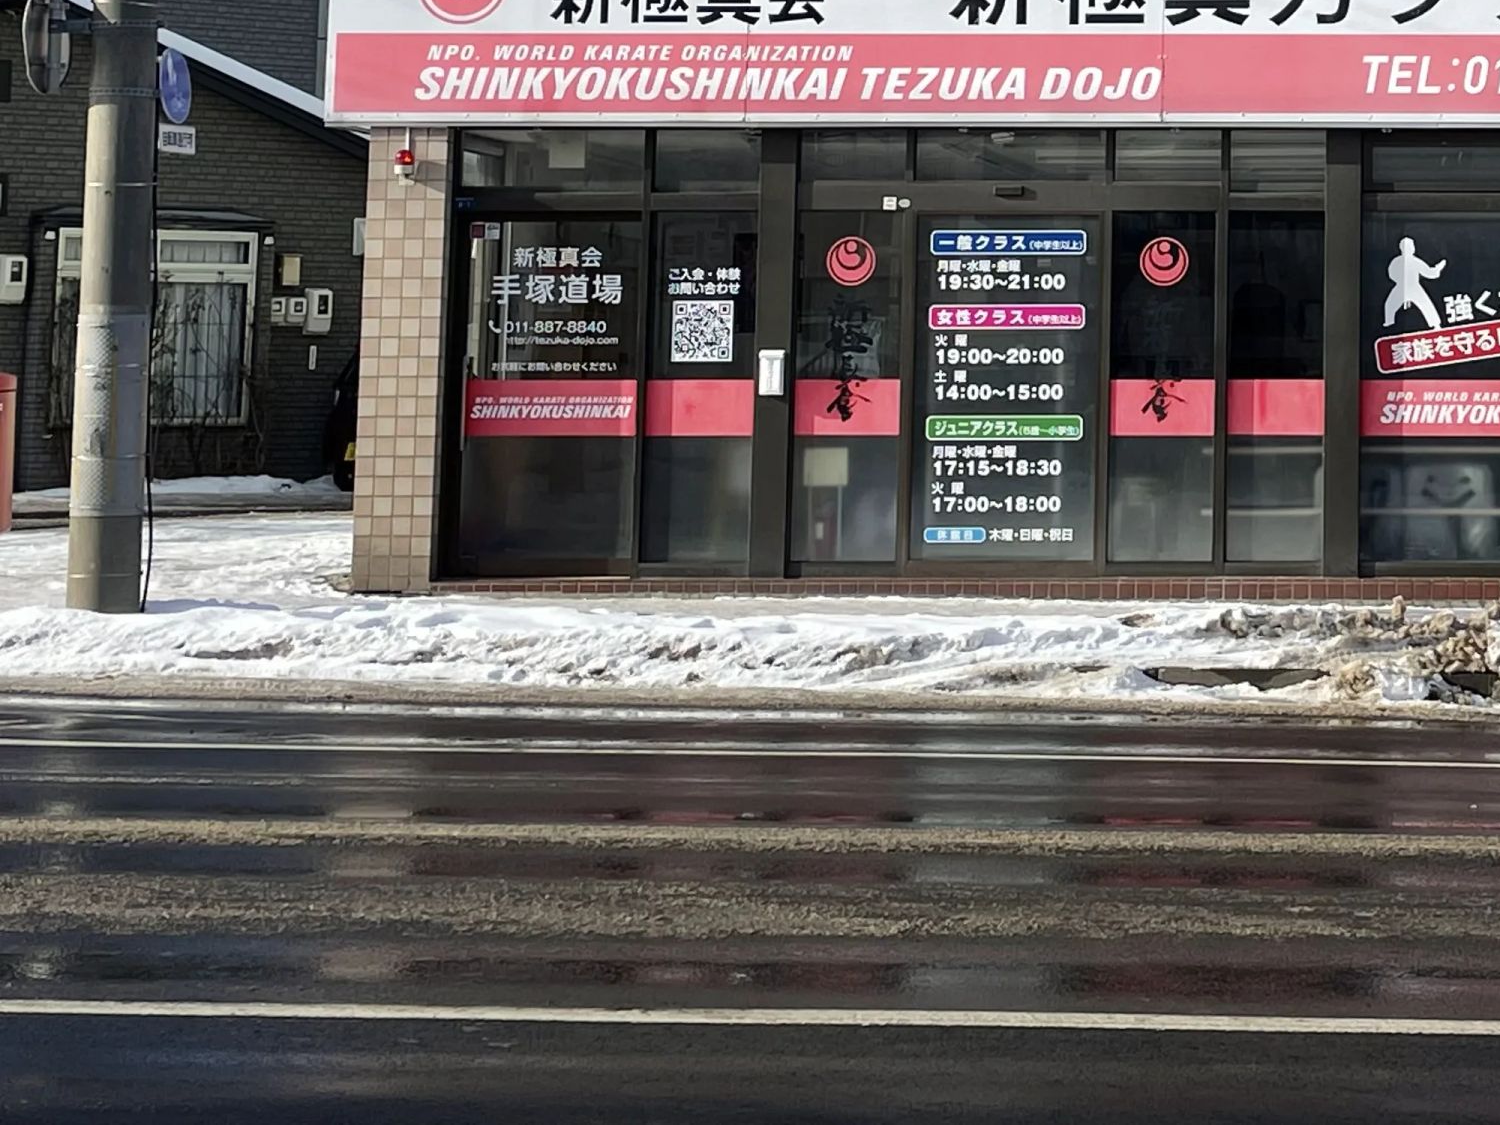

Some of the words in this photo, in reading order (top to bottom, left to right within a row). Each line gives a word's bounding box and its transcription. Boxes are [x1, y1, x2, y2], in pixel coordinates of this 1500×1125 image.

[493, 45, 575, 60] WORLD
[584, 45, 672, 60] KARATE
[681, 45, 853, 61] ORGANIZATION
[414, 66, 845, 101] SHINKYOKUSHINKAI
[859, 67, 1027, 101] TEZUKA
[1038, 67, 1161, 101] DOJO
[513, 246, 603, 267] 新極真会
[491, 274, 624, 305] 手塚道場
[668, 282, 741, 295] お問い合わせ
[505, 320, 607, 333] 011-887-8840
[1423, 392, 1468, 402] WORLD
[470, 405, 630, 419] SHINKYOKUSHINKAI
